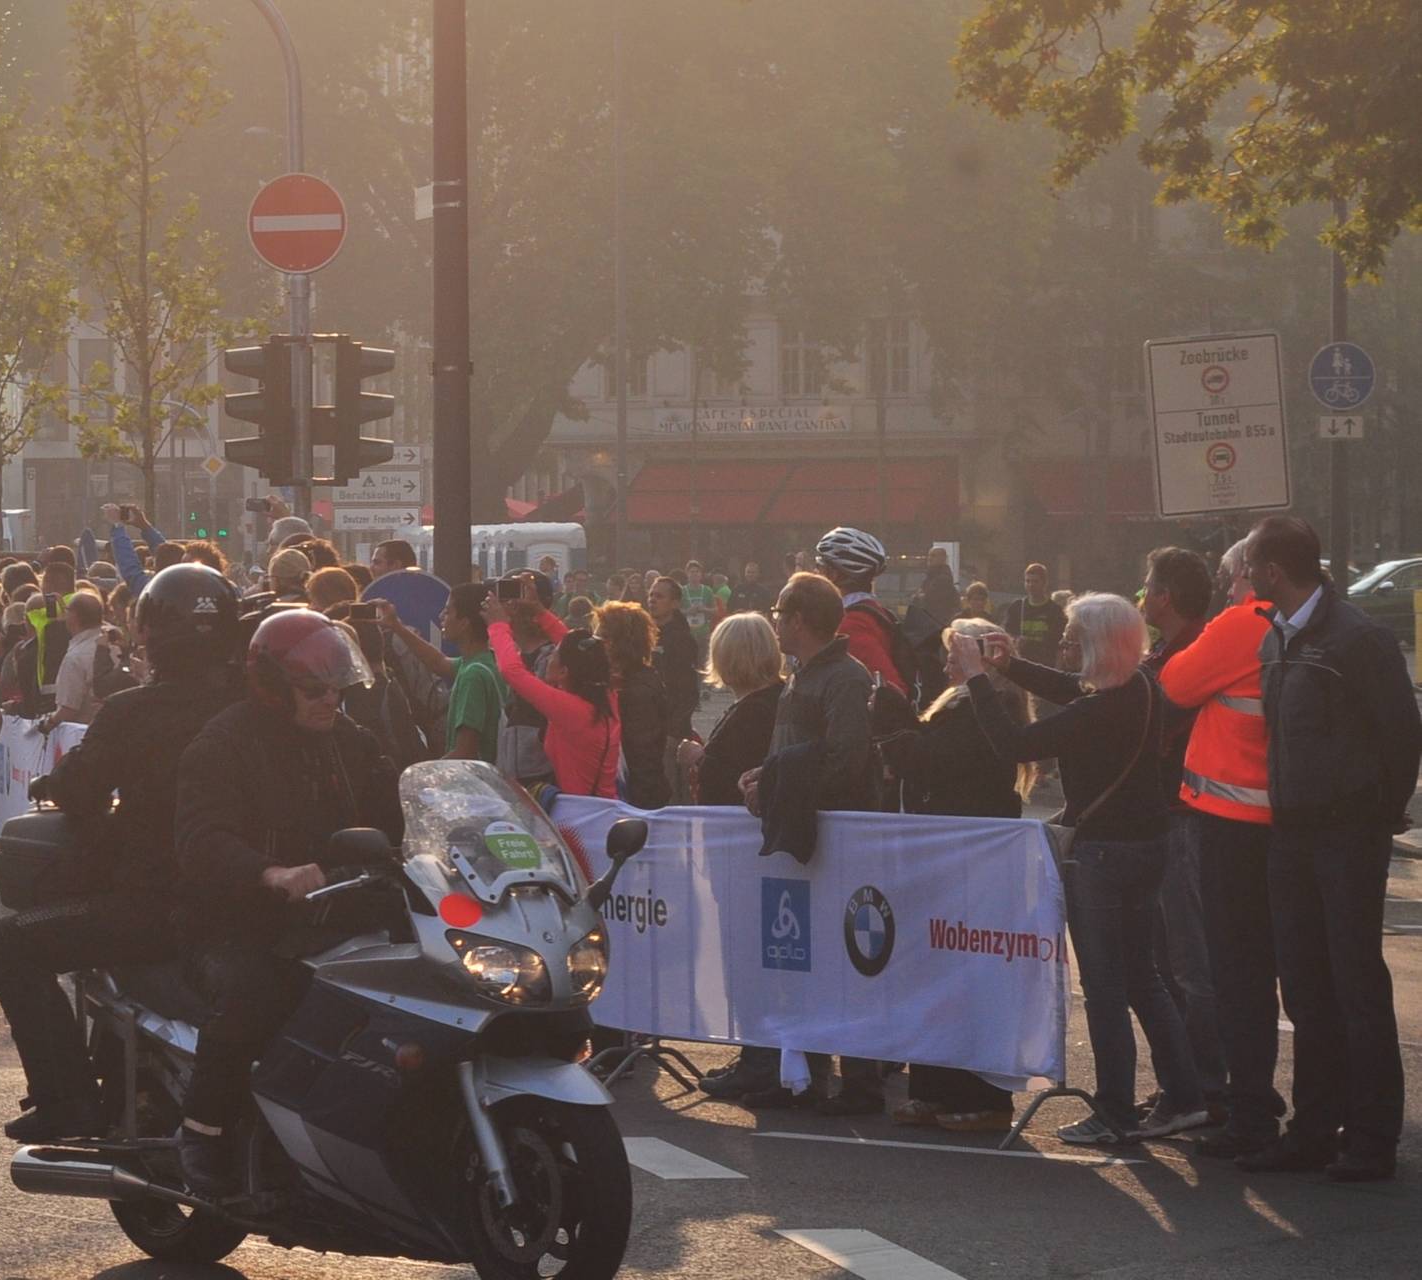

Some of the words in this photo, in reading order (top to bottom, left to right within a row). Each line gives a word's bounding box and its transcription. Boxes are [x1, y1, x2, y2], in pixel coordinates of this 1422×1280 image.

[1180, 347, 1249, 366] Zoobrücke
[1197, 411, 1240, 427] Tunnel
[1164, 429, 1242, 445] Stadtautobahn
[381, 475, 402, 485] DJH
[339, 490, 401, 501] Berufskolleg
[497, 838, 528, 848] Freie
[848, 888, 891, 918] BMW
[930, 919, 1039, 962] Wobenzym
